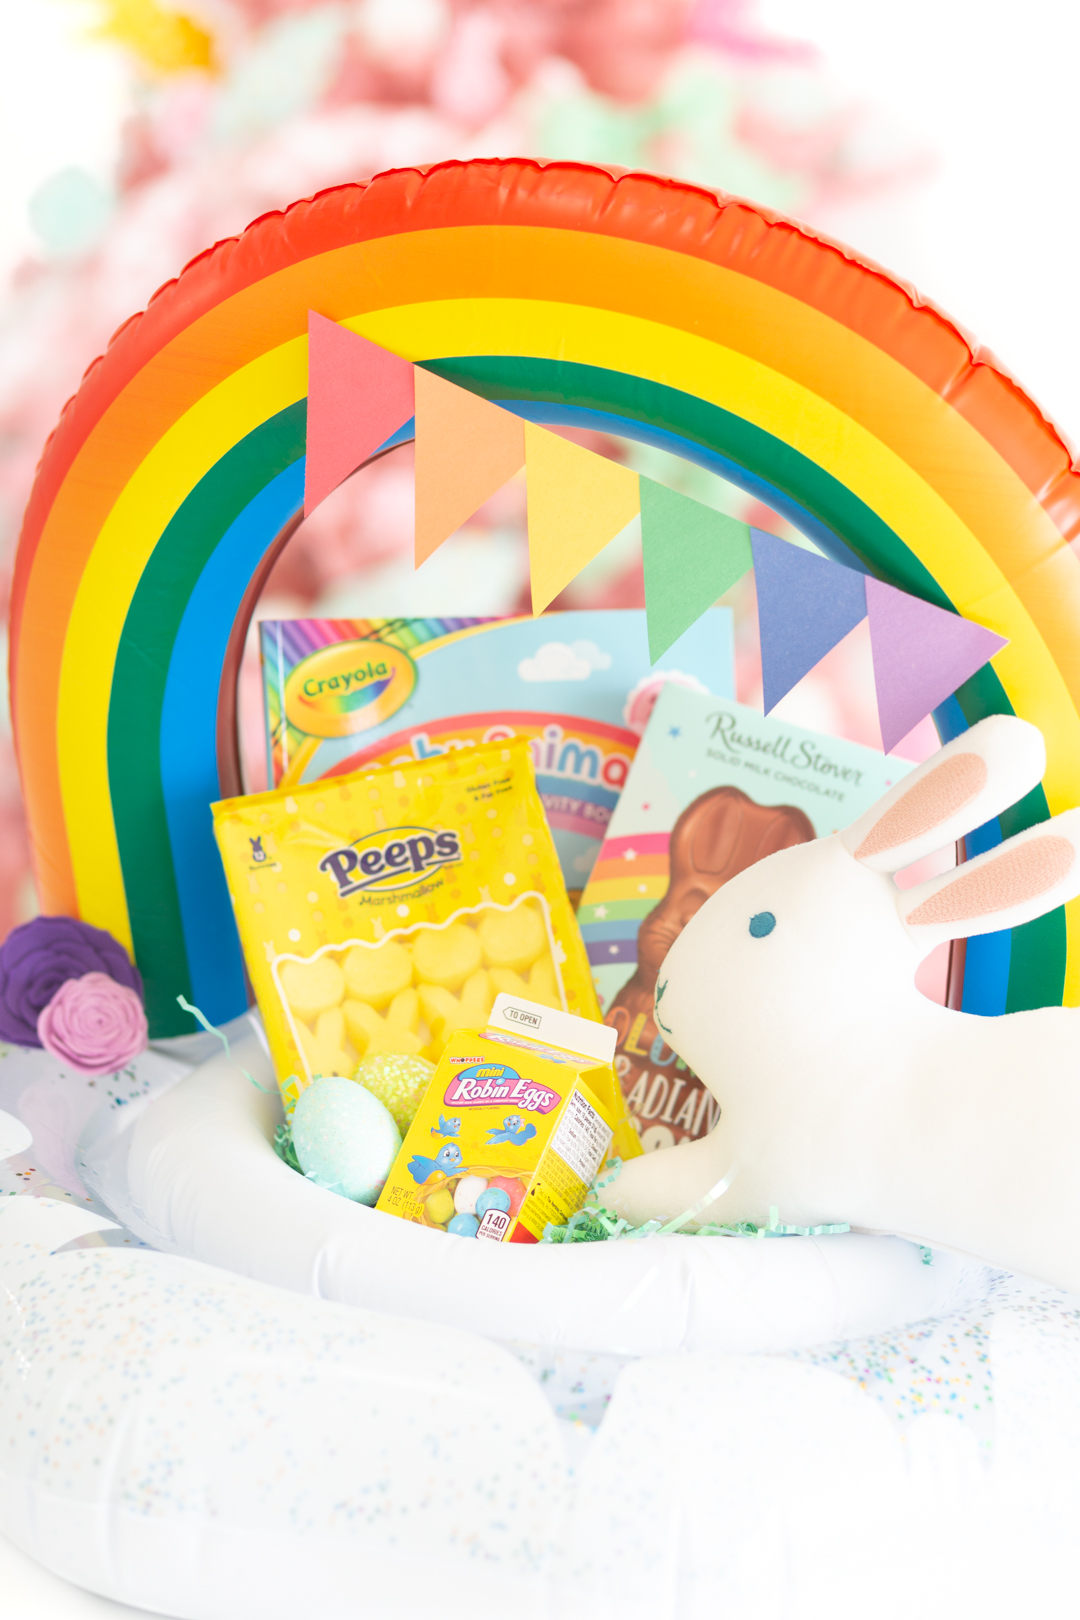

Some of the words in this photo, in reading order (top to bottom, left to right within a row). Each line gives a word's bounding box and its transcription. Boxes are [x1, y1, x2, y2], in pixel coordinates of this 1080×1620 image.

[303, 662, 388, 697] Crayola
[705, 711, 793, 764] Russell
[791, 739, 865, 787] Stover
[705, 748, 741, 766] SOLID
[743, 760, 772, 777] MILK
[774, 770, 846, 803] CHOCOLATE
[319, 831, 460, 889] Peeps
[358, 878, 444, 907] Marshmallow
[509, 1009, 518, 1020] TO
[520, 1013, 538, 1026] OPEN
[475, 1067, 505, 1078] mini
[451, 1078, 510, 1100] Robin
[509, 1078, 554, 1111] Eggs
[391, 1186, 403, 1196] NET
[403, 1189, 414, 1199] WT
[387, 1196, 392, 1204] 4
[392, 1197, 402, 1207] OZ
[485, 1213, 507, 1230] 140
[480, 1224, 503, 1237] CALORIES
[486, 1232, 501, 1242] SERVING
